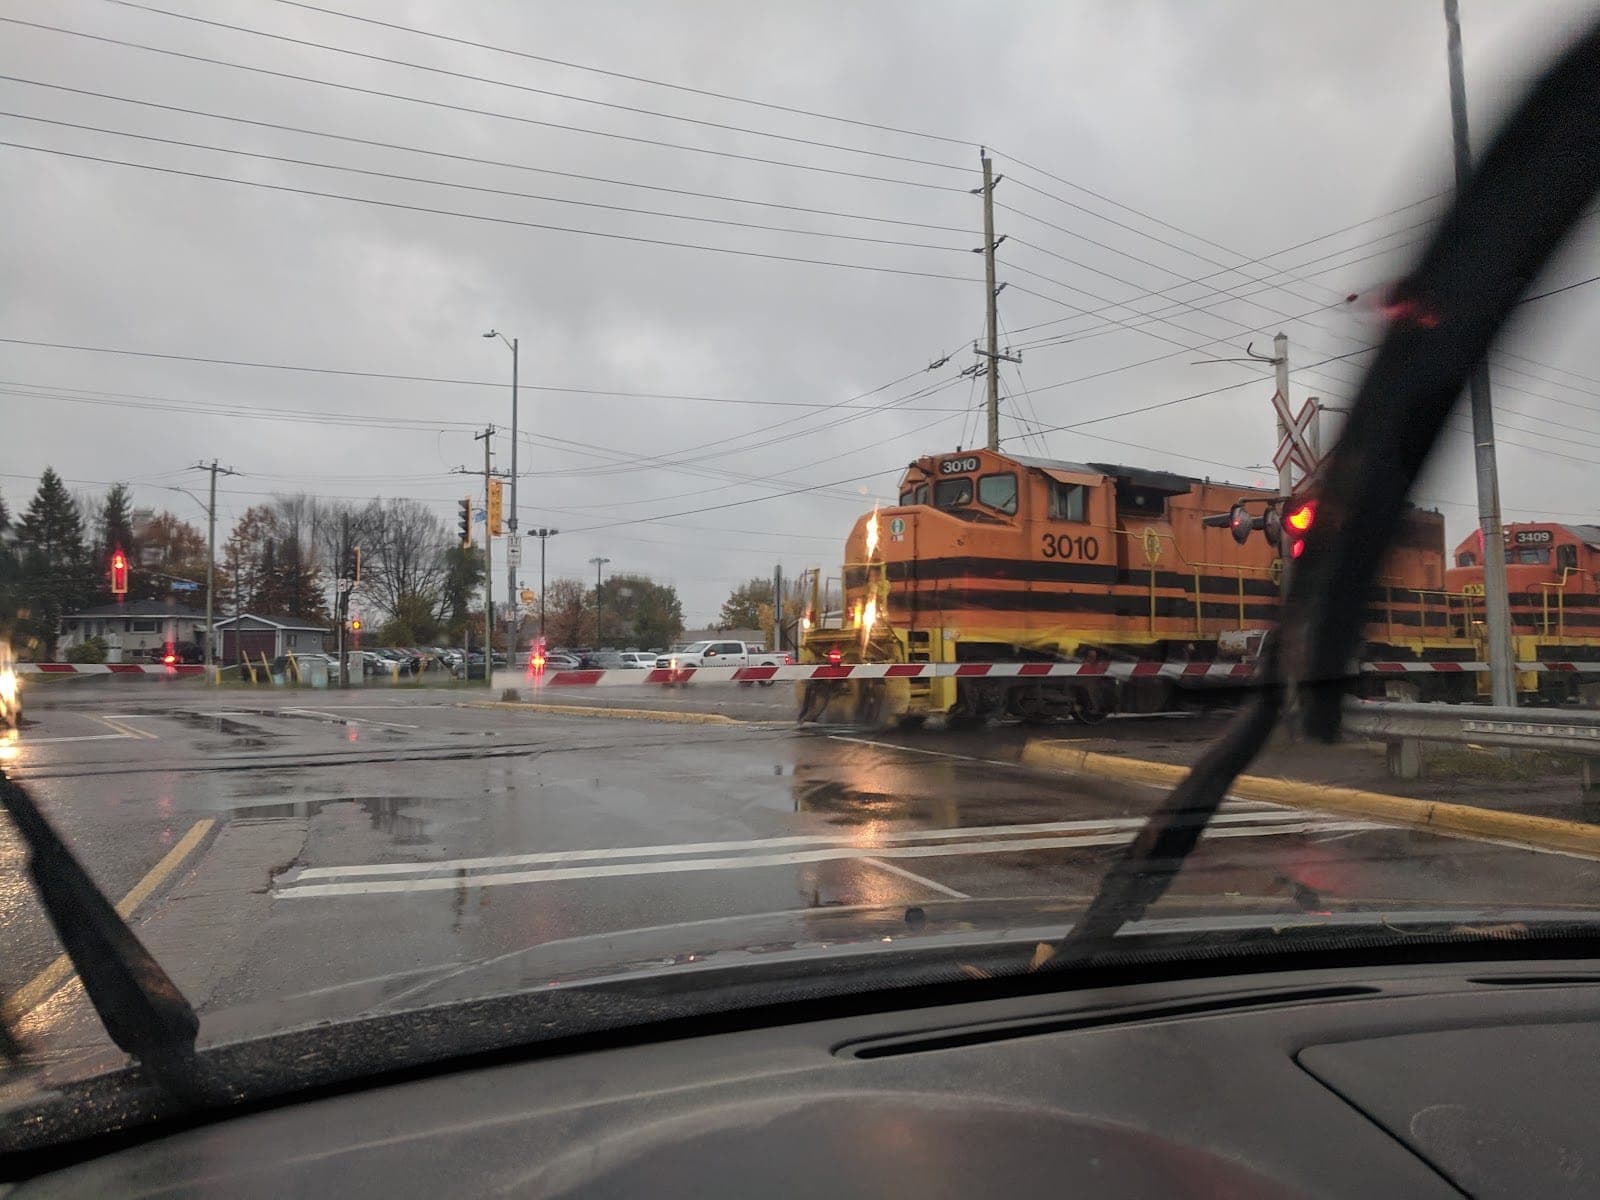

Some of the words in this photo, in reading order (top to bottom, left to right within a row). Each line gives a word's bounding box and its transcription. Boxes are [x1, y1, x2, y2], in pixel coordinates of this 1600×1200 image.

[943, 458, 976, 473] 3010
[1518, 532, 1550, 542] 3409
[1041, 533, 1099, 561] 3010
